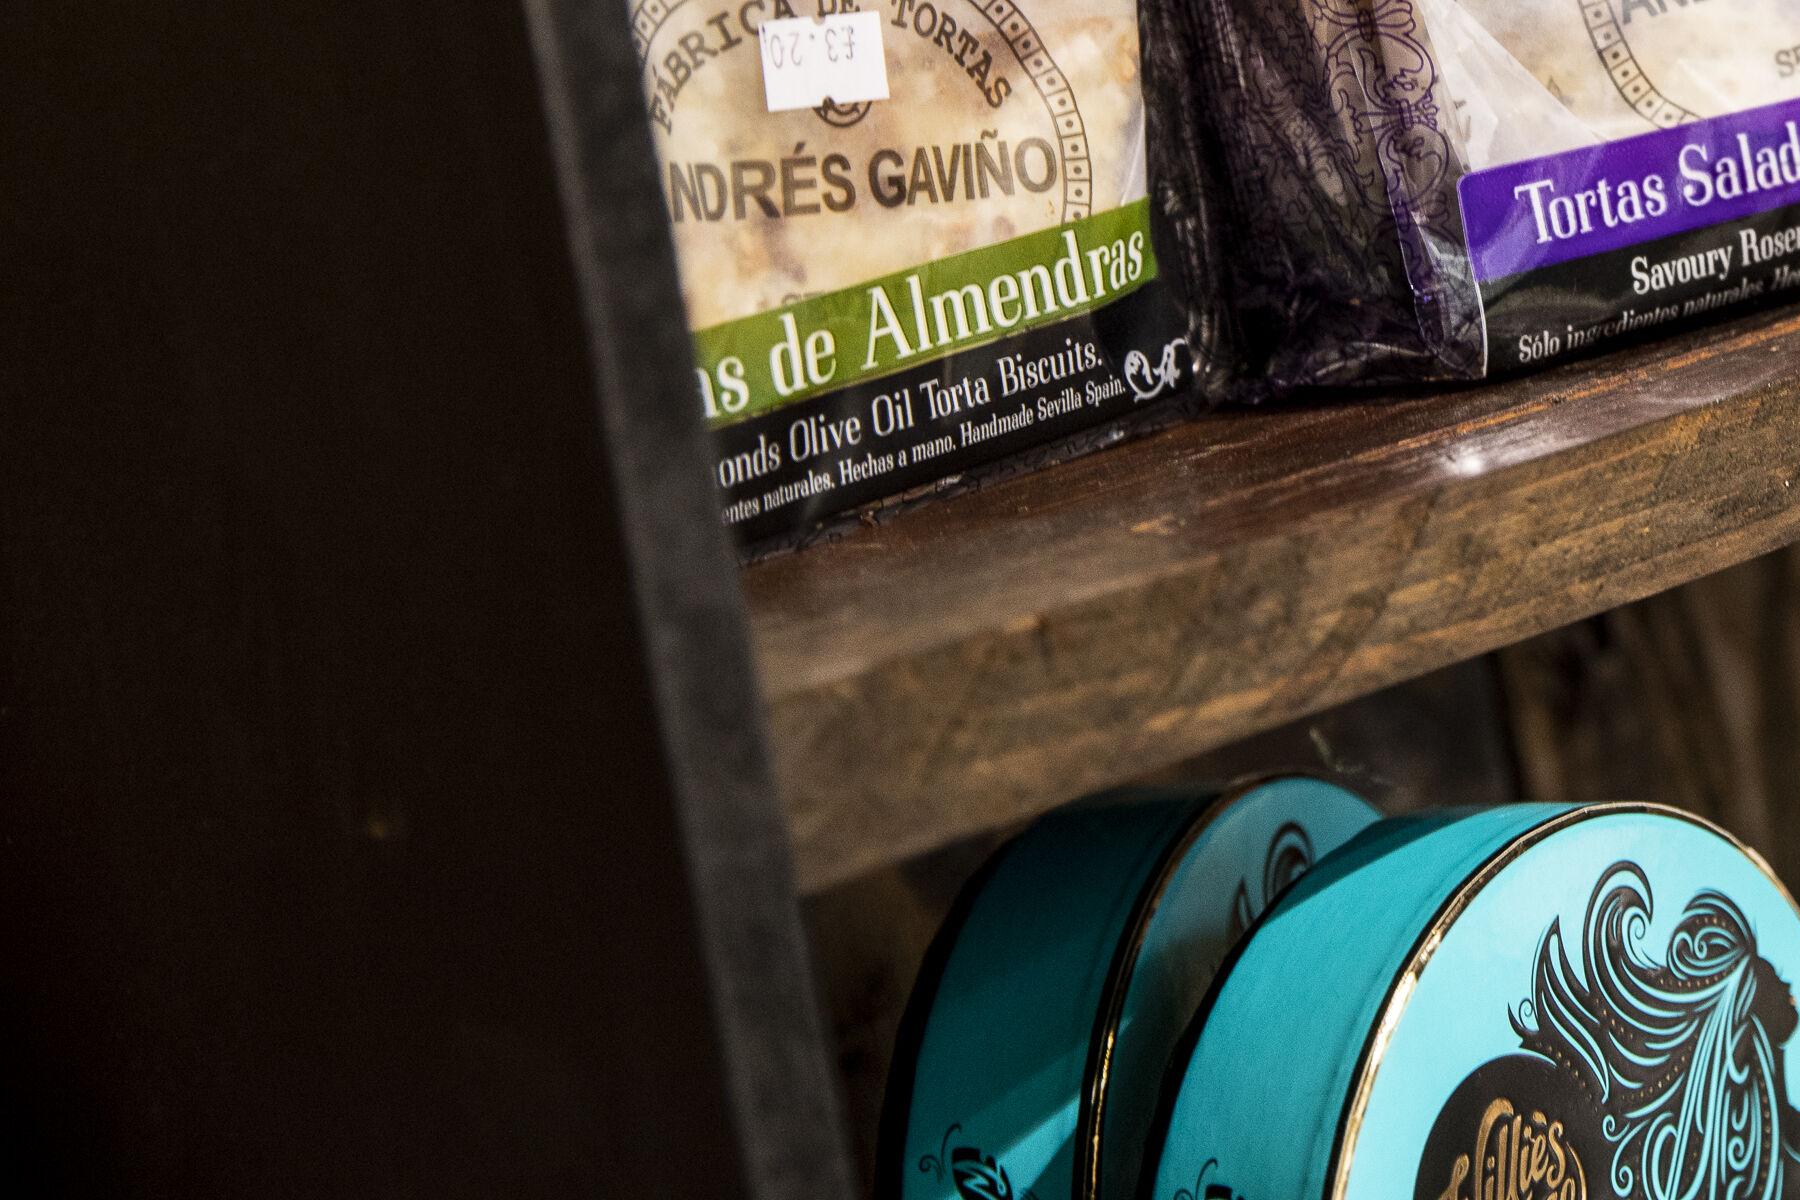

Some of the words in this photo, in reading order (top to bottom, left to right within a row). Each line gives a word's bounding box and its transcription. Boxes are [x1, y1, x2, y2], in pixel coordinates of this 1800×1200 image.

[669, 142, 857, 224] NDRÉS
[868, 129, 1058, 208] GAVIÑO
[1514, 174, 1668, 245] Tortas
[769, 312, 837, 397] de
[860, 229, 1144, 370] Almendras
[1630, 246, 1734, 295] Savoury
[1518, 330, 1561, 364] Sólo
[1567, 304, 1680, 350] ingredientes
[713, 433, 781, 489] onds
[789, 413, 862, 463] Olive
[871, 388, 915, 437] Oil
[919, 375, 991, 421] Torta
[996, 337, 1103, 397] Biscuits.
[838, 450, 894, 486] Hechas
[898, 449, 908, 468] a
[960, 403, 1034, 448] Handmade
[1037, 386, 1082, 421] Sevilla
[1085, 374, 1127, 407] Spain.
